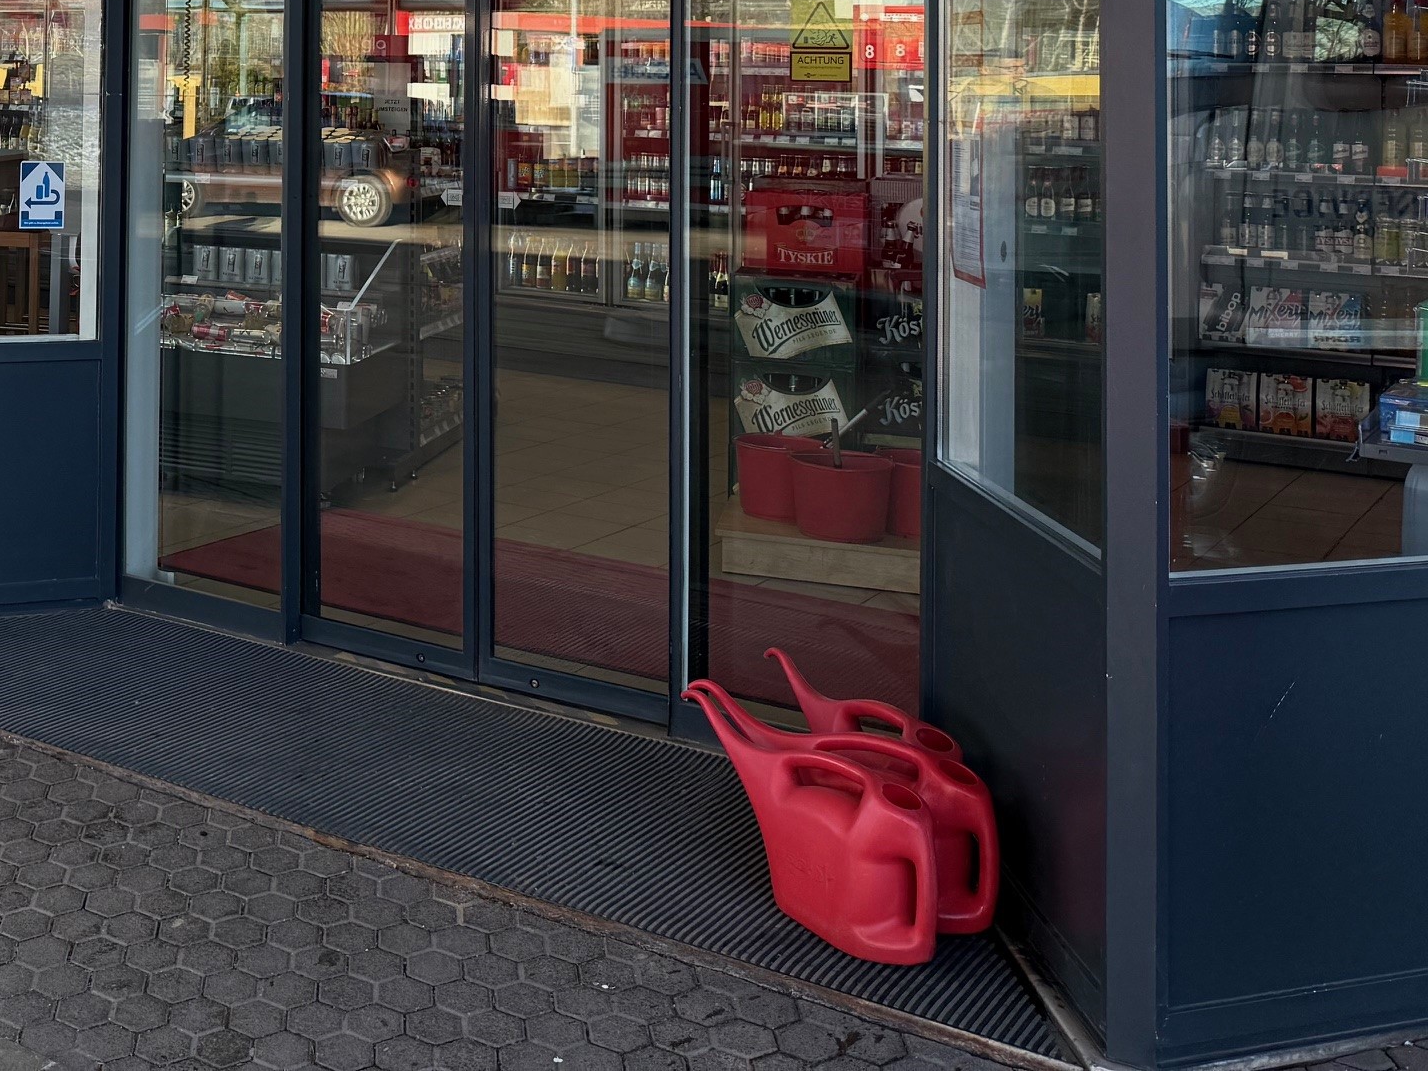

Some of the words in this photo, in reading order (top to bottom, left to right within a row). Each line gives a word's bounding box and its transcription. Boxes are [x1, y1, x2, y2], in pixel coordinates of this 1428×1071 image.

[796, 55, 845, 65] ACHTUNG
[777, 247, 834, 265] TYSKIE
[752, 307, 841, 353] Wernesgrüner
[751, 394, 841, 433] Wernesgrüner
